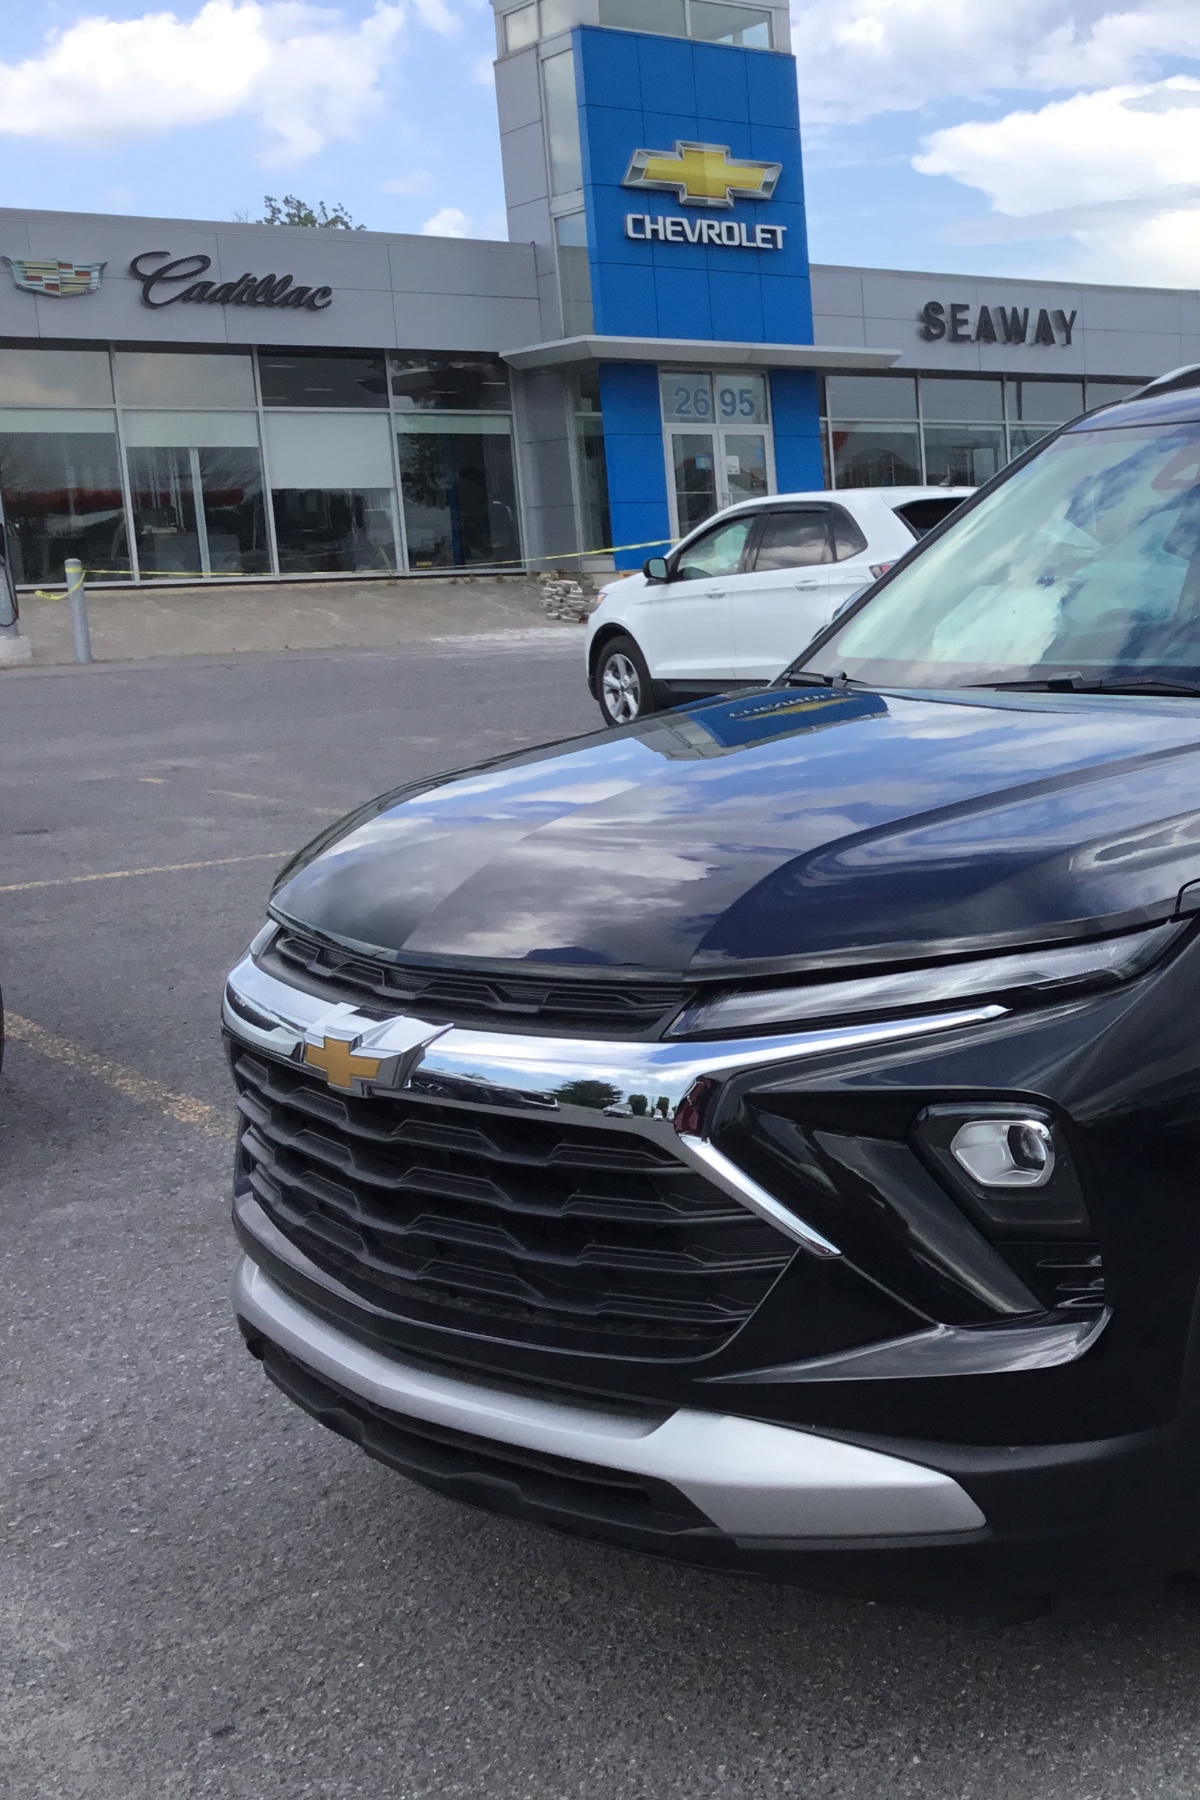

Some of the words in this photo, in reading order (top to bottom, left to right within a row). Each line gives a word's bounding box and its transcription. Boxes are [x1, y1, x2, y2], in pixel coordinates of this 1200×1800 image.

[625, 213, 788, 249] CHEVROLET
[130, 251, 333, 309] Cadillac
[920, 301, 1078, 346] SEAWAY
